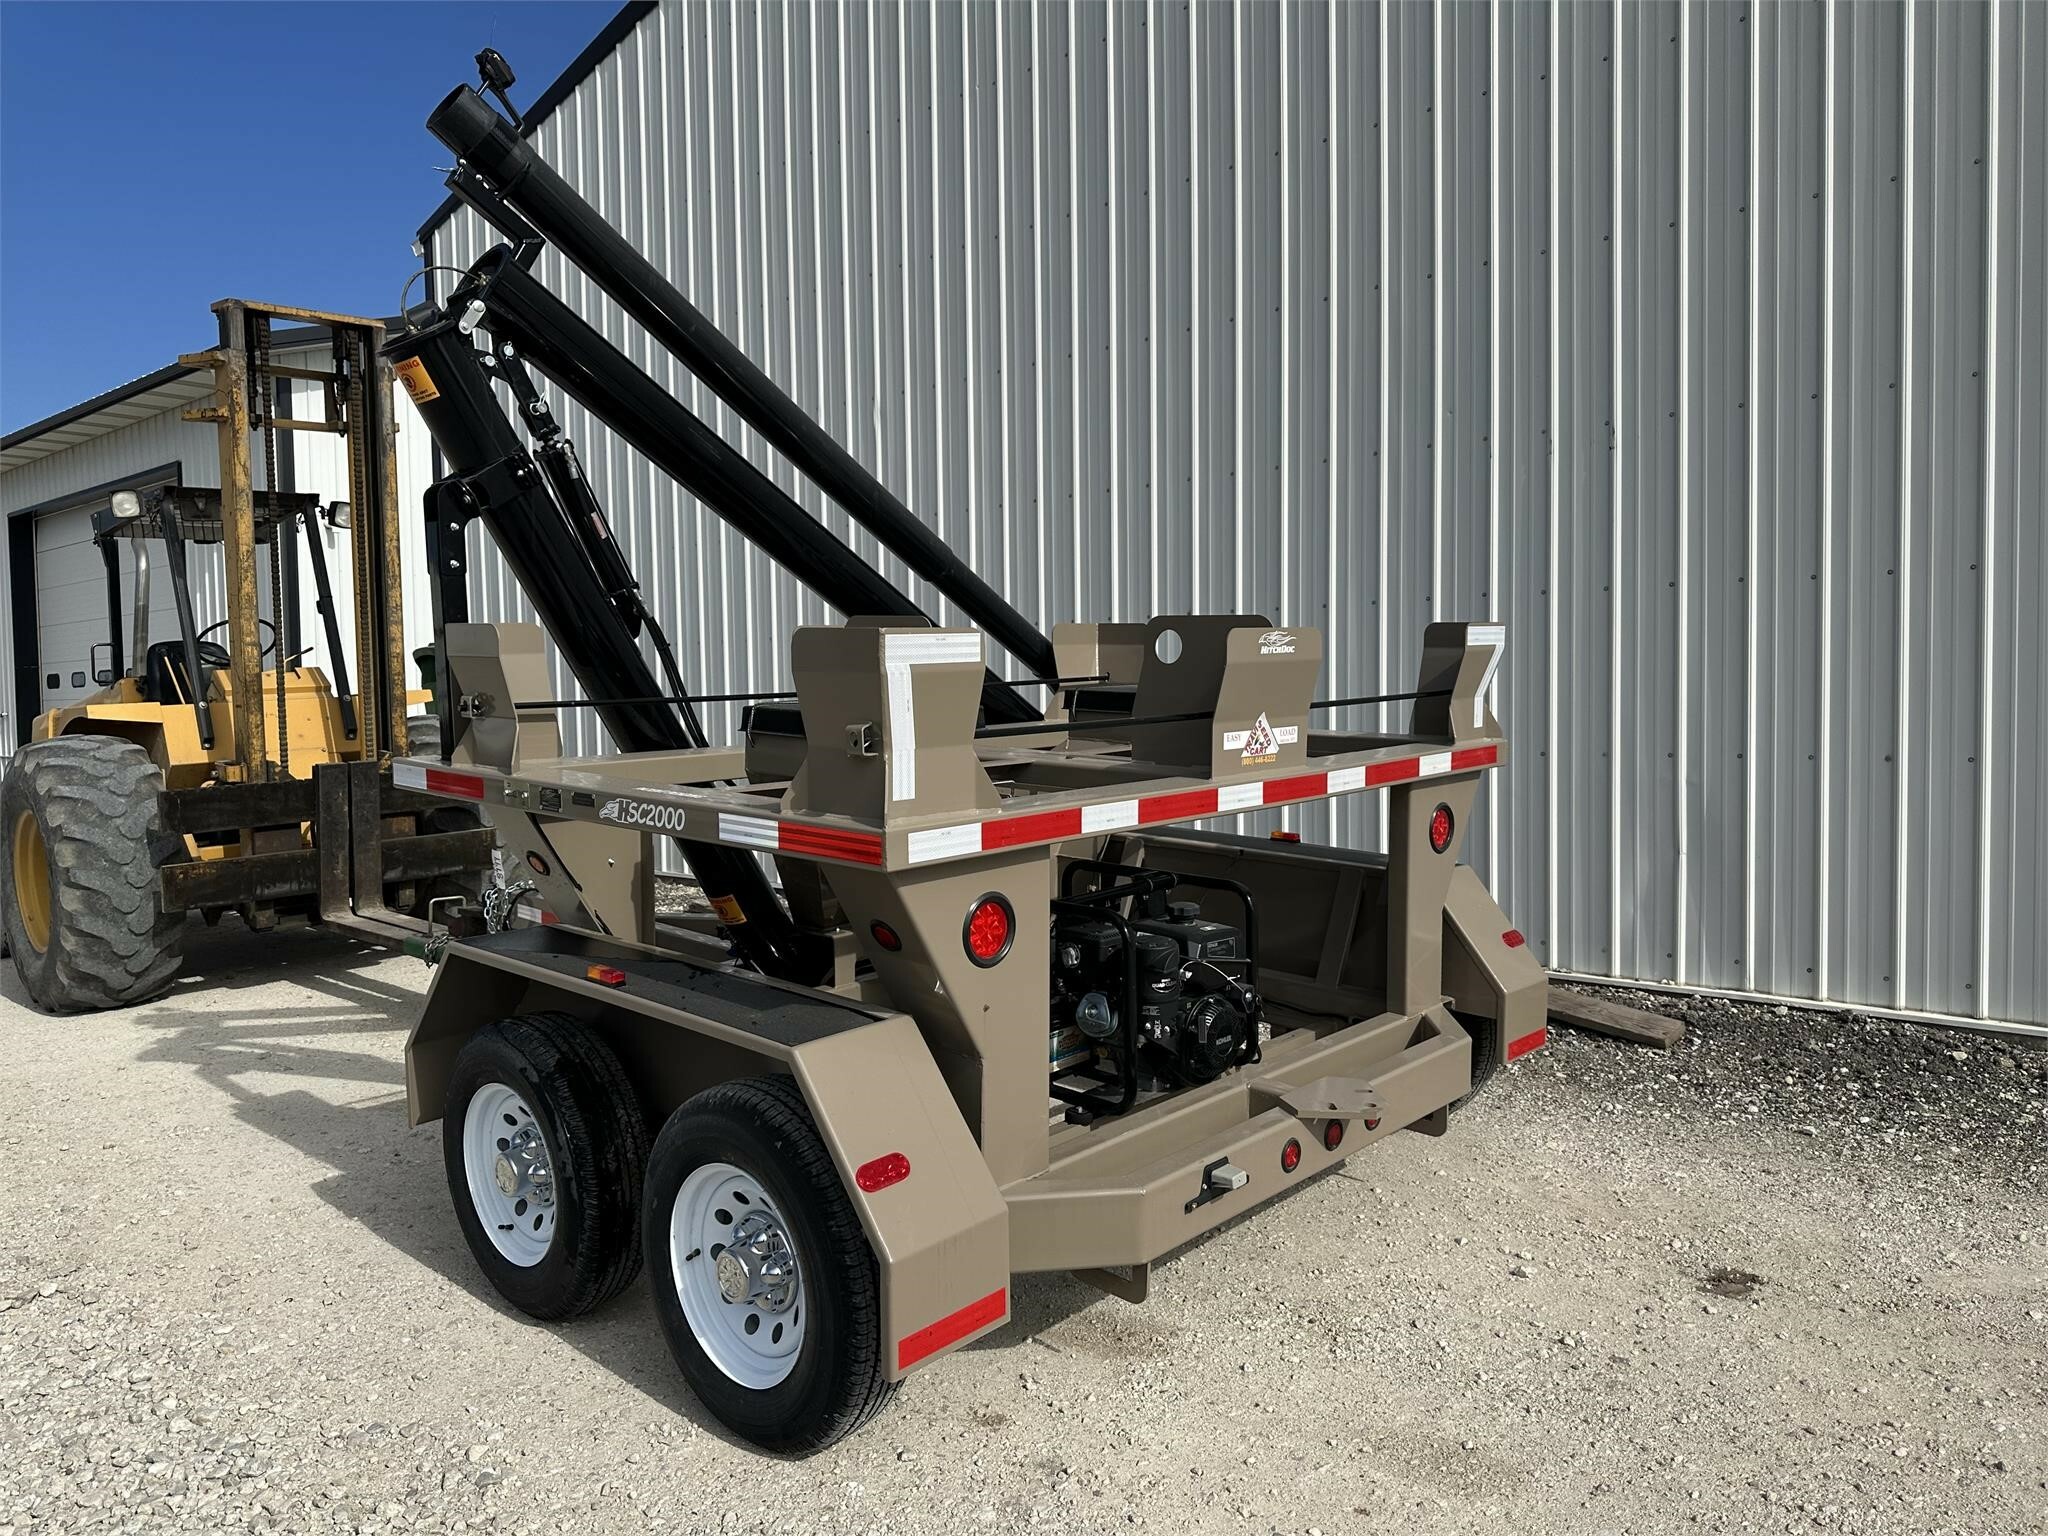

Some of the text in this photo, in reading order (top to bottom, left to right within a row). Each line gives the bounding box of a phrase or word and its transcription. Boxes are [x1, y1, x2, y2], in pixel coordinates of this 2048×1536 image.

[1280, 727, 1296, 737] LOAD
[1226, 733, 1241, 743] EASY
[1249, 746, 1269, 756] CART
